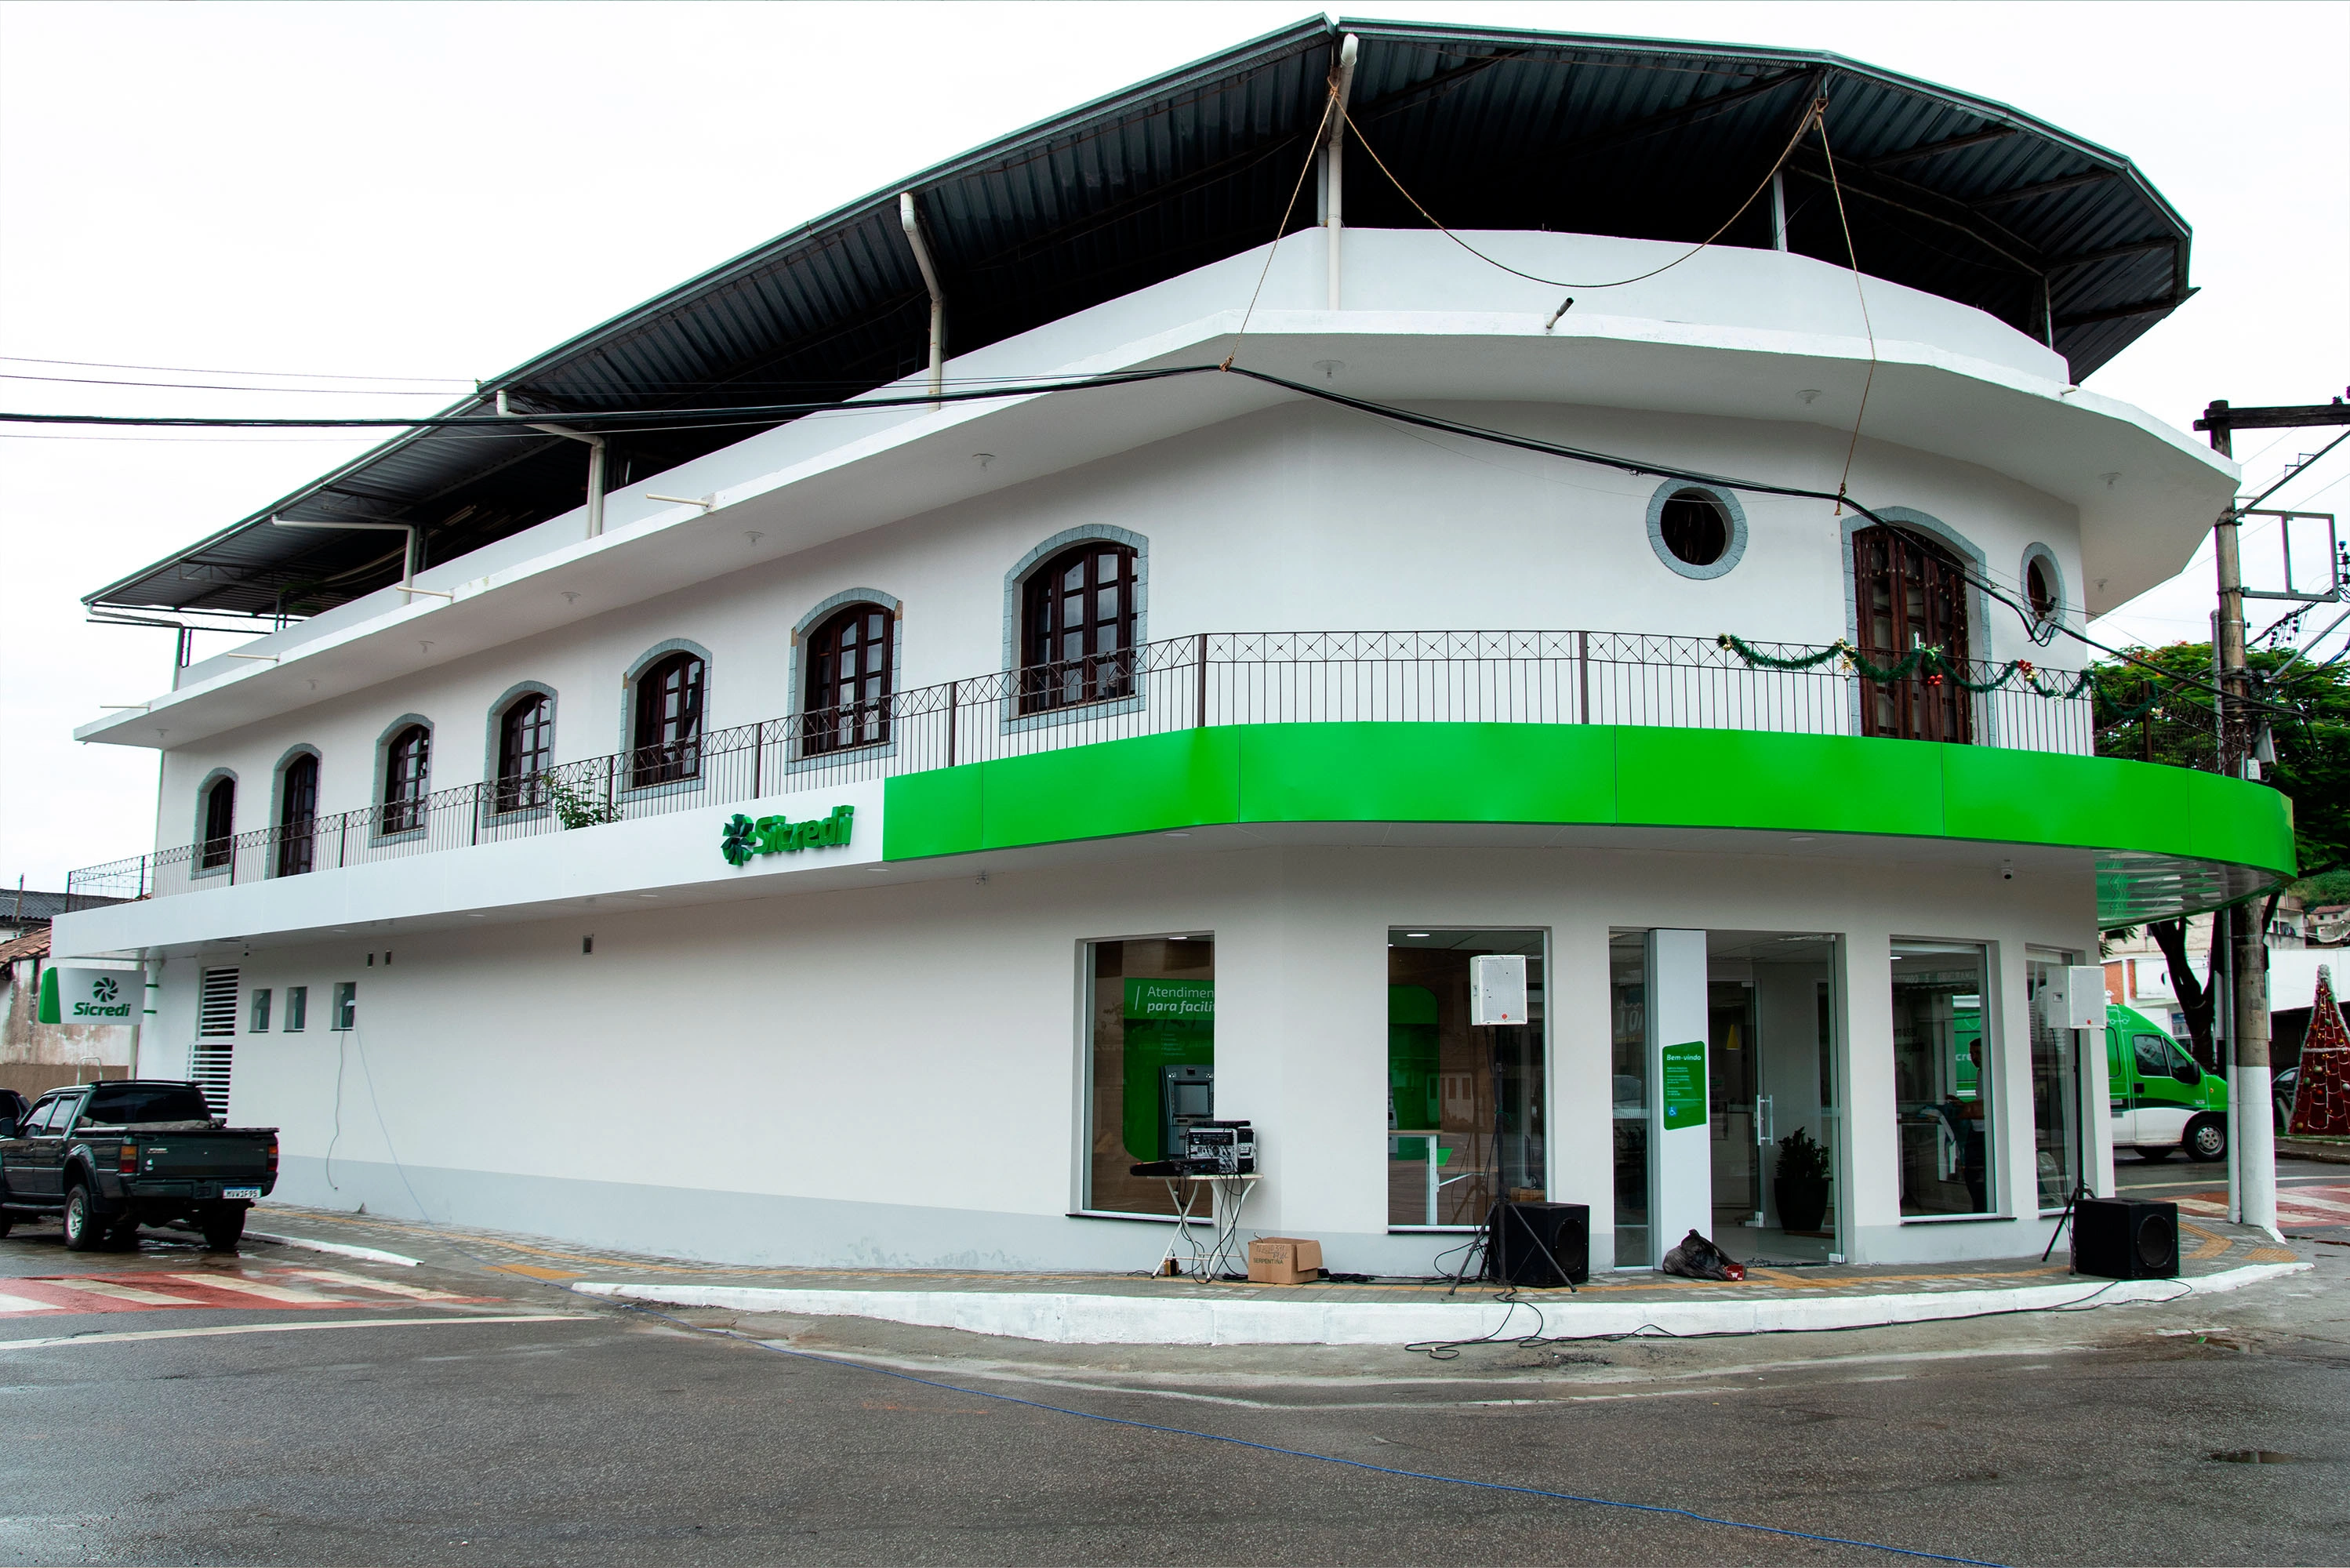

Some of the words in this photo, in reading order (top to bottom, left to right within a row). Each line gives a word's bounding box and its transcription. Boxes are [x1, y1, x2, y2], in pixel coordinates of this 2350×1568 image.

[753, 805, 854, 855] Sicredi
[1147, 985, 1214, 998] Atendimen
[73, 1002, 131, 1016] Sicredi
[1147, 1003, 1177, 1014] para
